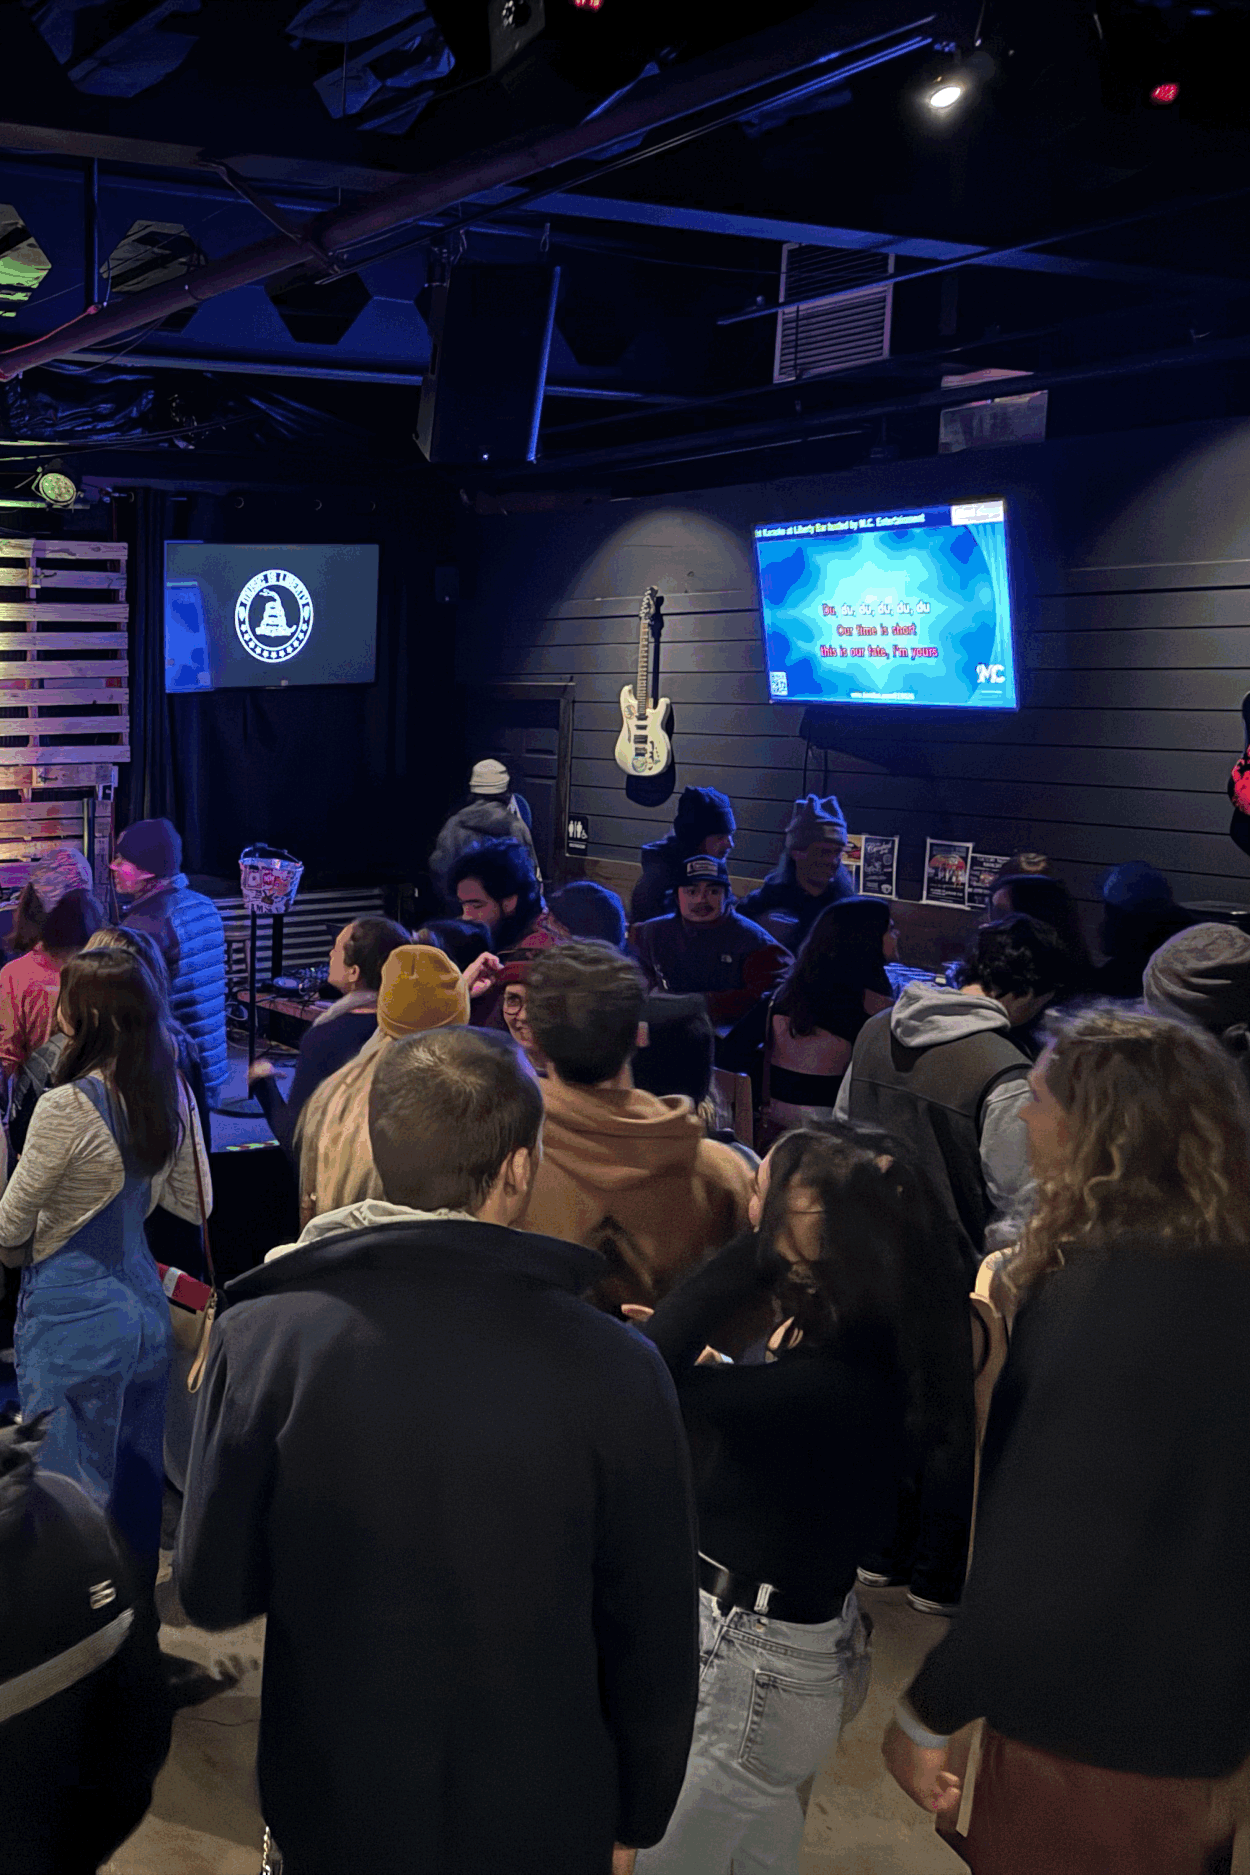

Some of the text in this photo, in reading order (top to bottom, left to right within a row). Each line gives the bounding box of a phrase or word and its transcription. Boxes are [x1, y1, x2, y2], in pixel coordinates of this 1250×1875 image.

[916, 599, 931, 614] du
[836, 624, 854, 637] Our
[856, 624, 878, 636] time
[880, 623, 889, 636] is
[839, 644, 848, 657] is
[850, 647, 865, 657] our
[911, 646, 938, 660] yours
